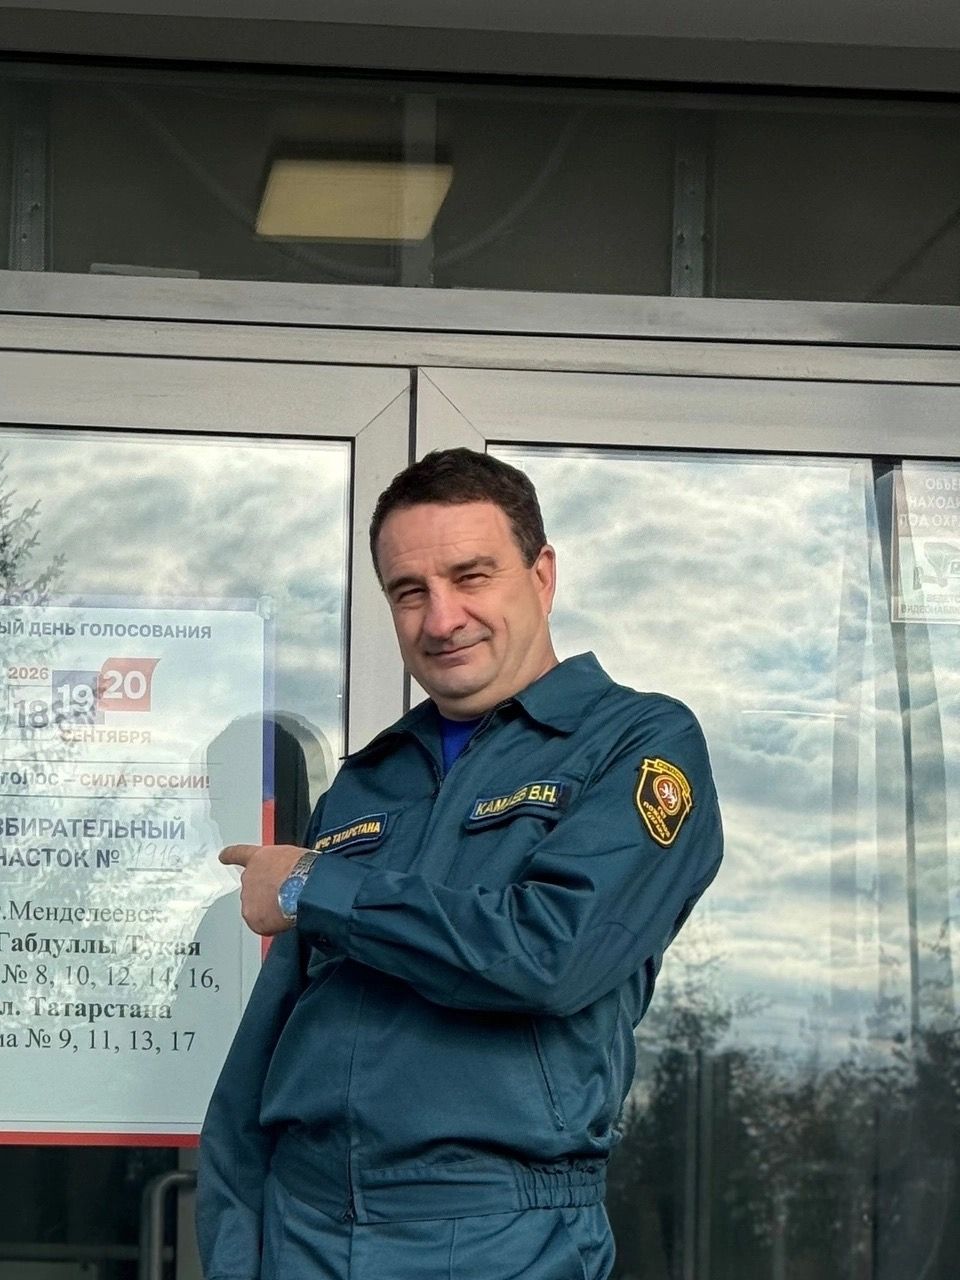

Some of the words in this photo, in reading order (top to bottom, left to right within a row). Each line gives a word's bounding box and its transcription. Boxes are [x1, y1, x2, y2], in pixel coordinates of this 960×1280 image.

[926, 479, 960, 490] ОБЪЕ
[933, 514, 960, 527] ОХР
[28, 621, 75, 637] ДЕНЬ
[80, 623, 211, 639] ГОЛОСОВАНИЯ
[8, 667, 49, 679] 2026
[13, 699, 48, 728] 18
[56, 684, 94, 713] 19
[102, 670, 147, 699] 20
[61, 729, 152, 744] СЕНТЯБРЯ
[0, 771, 59, 785] ГОЛОС
[80, 773, 127, 788] СИЛА
[133, 774, 210, 789] РОССИИ!
[528, 785, 557, 803] В.Н.
[96, 849, 120, 868] №
[1, 964, 27, 984] №
[36, 964, 54, 987] 8,
[65, 965, 96, 989] 10,
[107, 966, 136, 989] 12,
[189, 967, 220, 992] 16,
[32, 997, 172, 1022] Татарстана
[24, 1028, 51, 1048] №
[59, 1029, 78, 1052] 9,
[89, 1030, 119, 1053] 11,
[130, 1030, 161, 1053] 13,
[170, 1031, 196, 1052] 17
